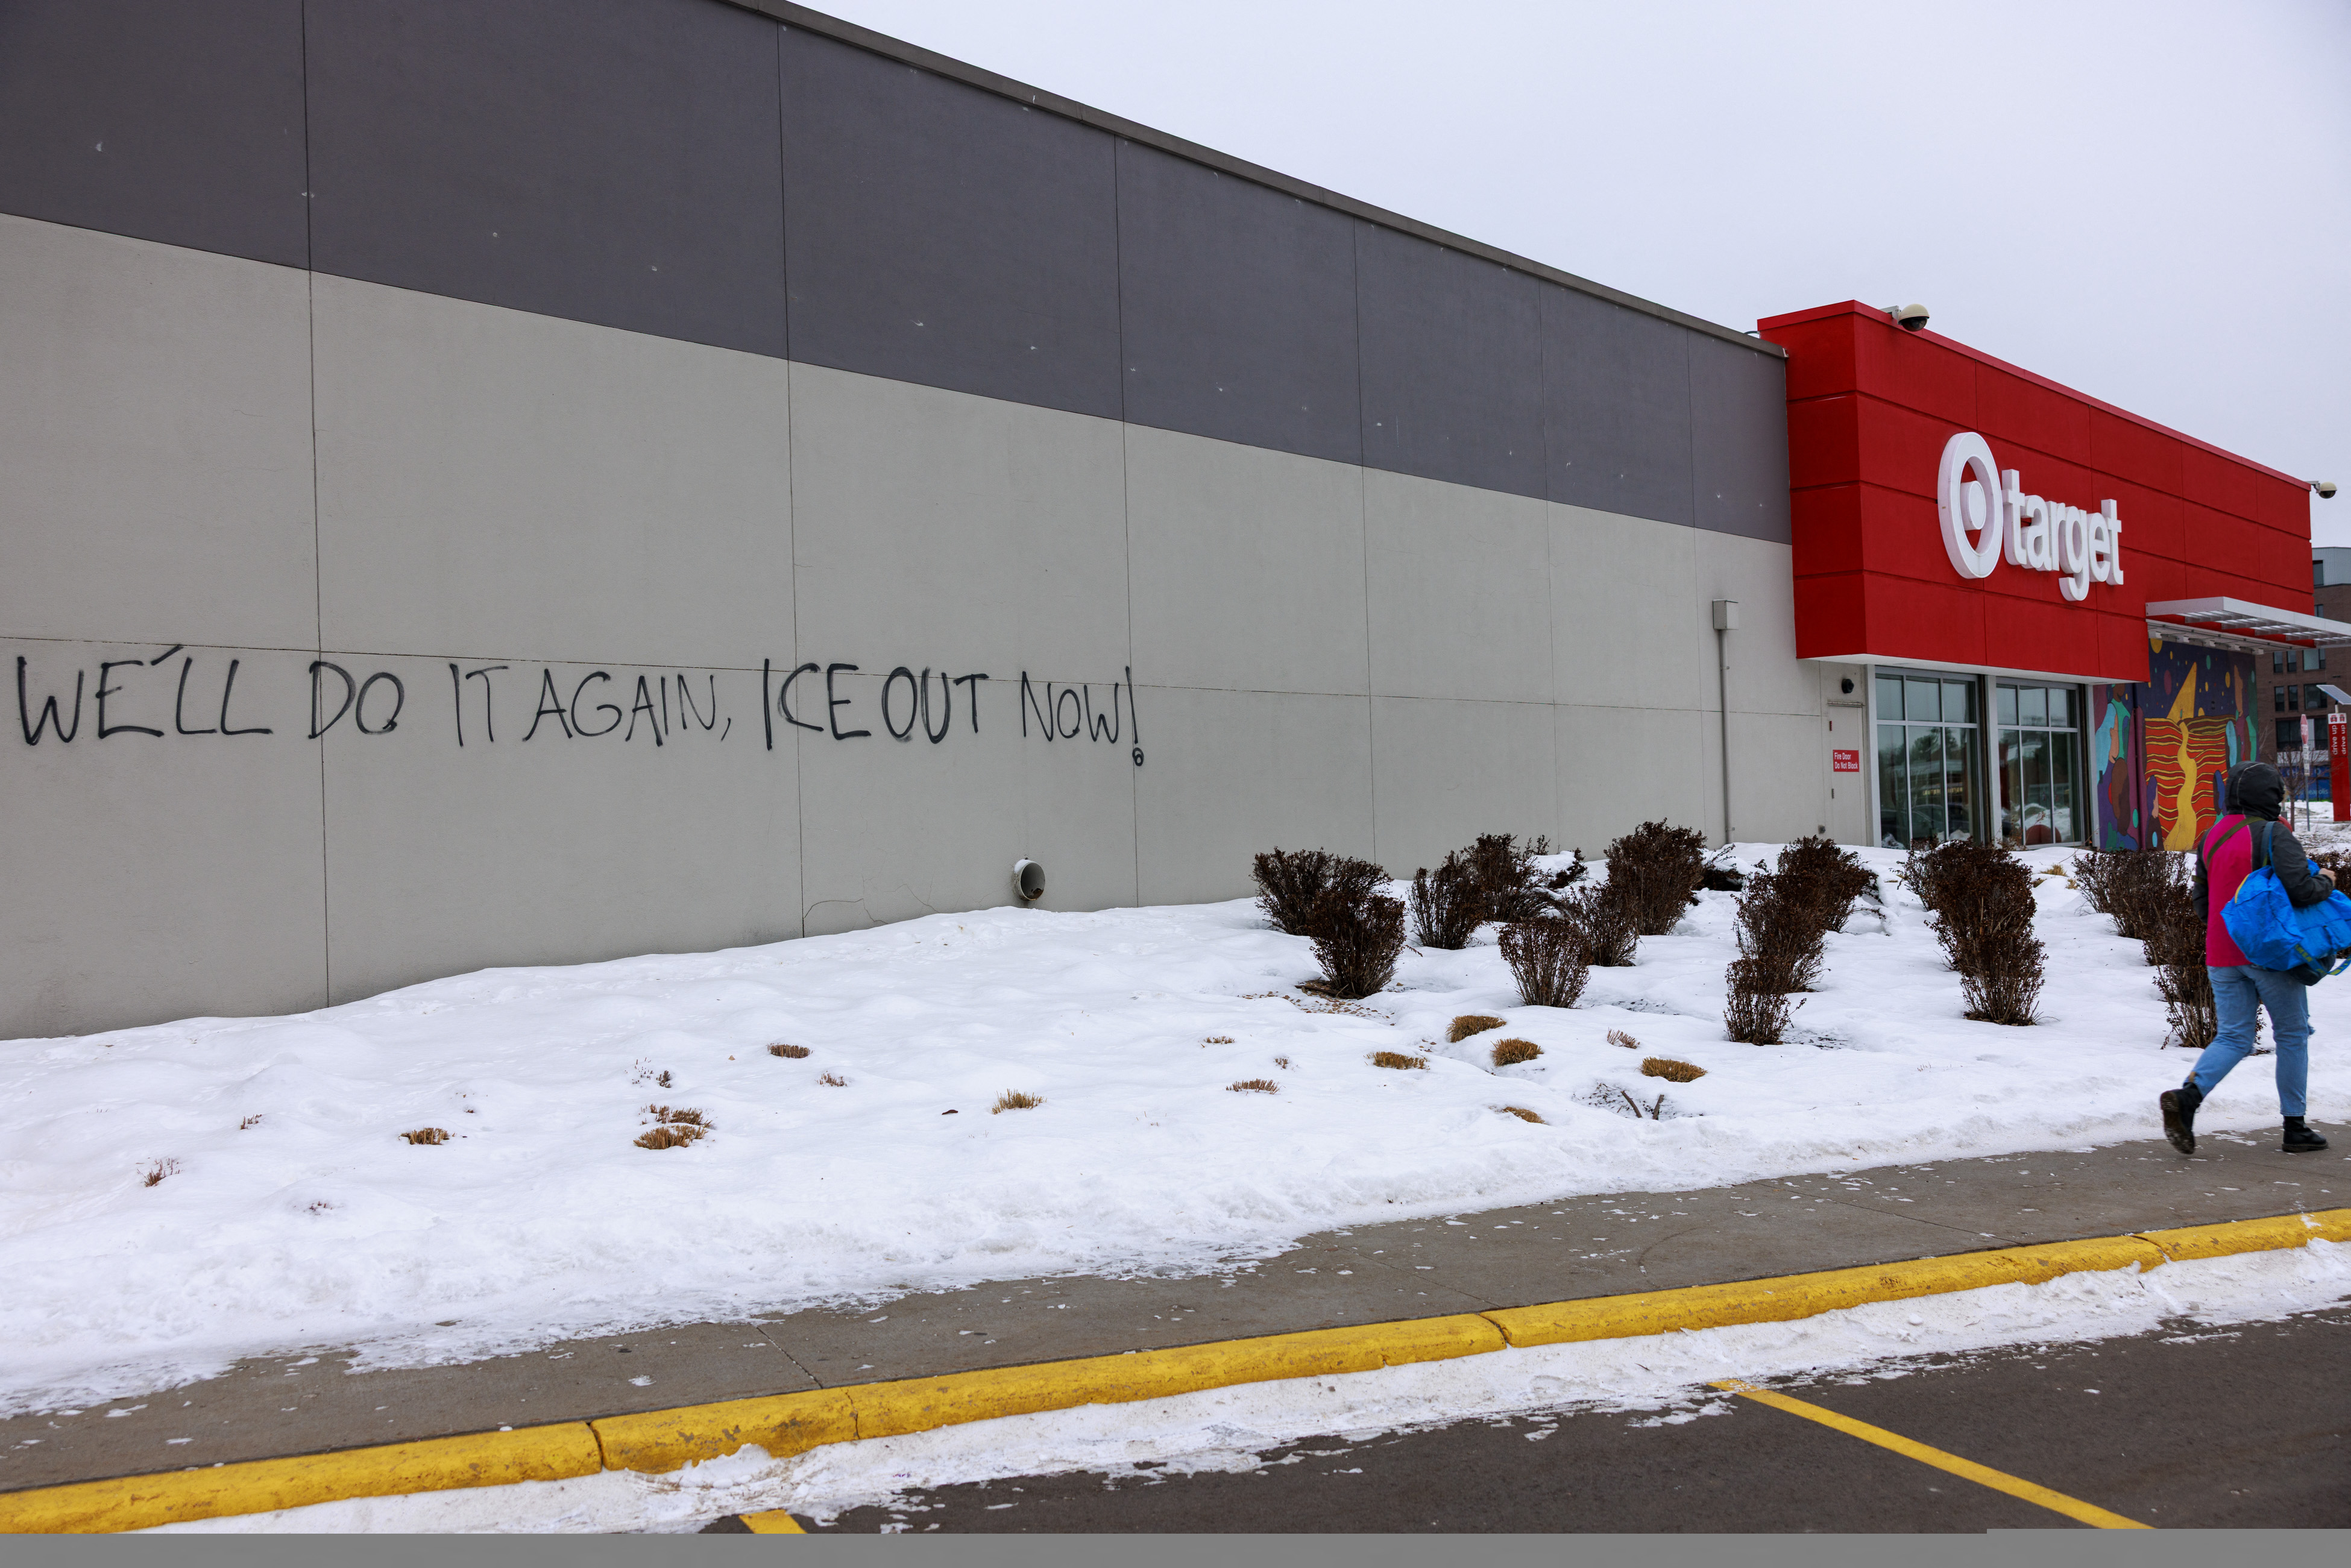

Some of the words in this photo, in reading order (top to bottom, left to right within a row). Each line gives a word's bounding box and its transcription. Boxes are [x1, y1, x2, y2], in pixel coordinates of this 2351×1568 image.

[2001, 468, 2123, 601] target
[17, 644, 274, 746] WE'LL
[308, 660, 405, 740] DO
[449, 663, 509, 747] IT
[523, 668, 732, 748] AGAIN,
[763, 658, 872, 751] ICE
[881, 666, 989, 744] OUT
[1021, 666, 1144, 767] NOW!
[2332, 725, 2338, 735] up
[2341, 725, 2346, 734] up
